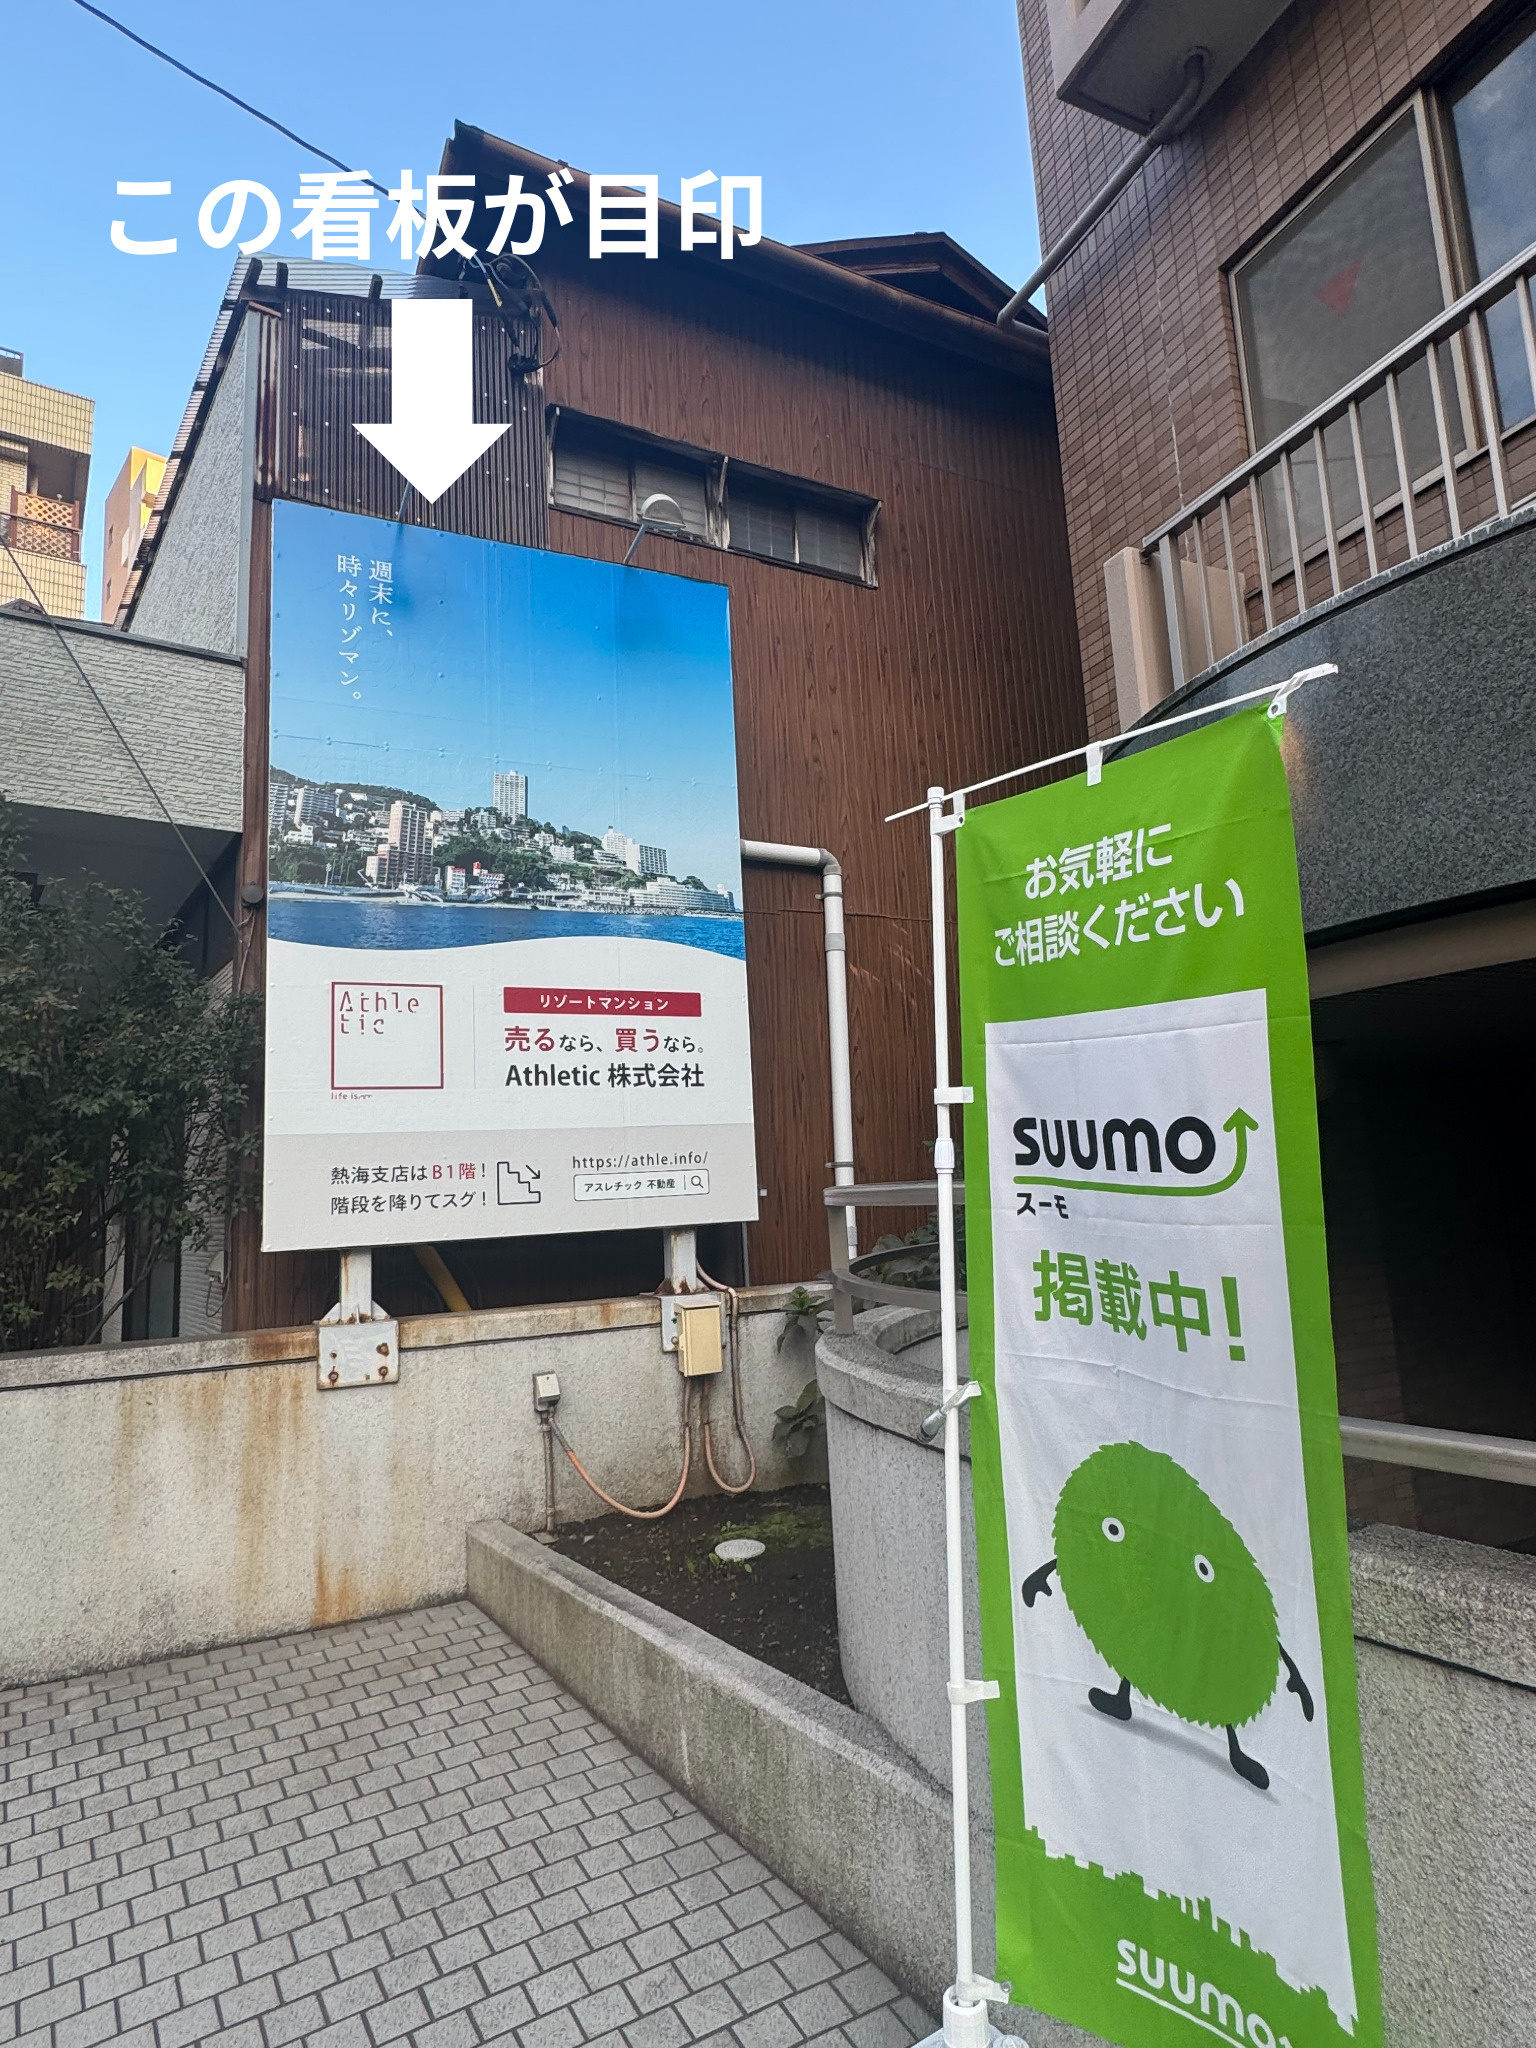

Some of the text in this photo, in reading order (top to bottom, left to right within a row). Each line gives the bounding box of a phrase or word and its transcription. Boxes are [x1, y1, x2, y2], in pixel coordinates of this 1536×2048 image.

[368, 559, 394, 637] 週末に、
[337, 554, 363, 700] 時々リゾマン。
[1024, 822, 1174, 899] お気軽に
[994, 877, 1245, 968] ご相談ください
[339, 990, 420, 1014] Athle
[540, 994, 669, 1011] リゾートマンション
[505, 1062, 705, 1088] Athletic 株式会社
[572, 1151, 709, 1171] https://athle.info/
[584, 1178, 676, 1192] アスレチック 不動産
[1016, 1192, 1070, 1220] スーモ
